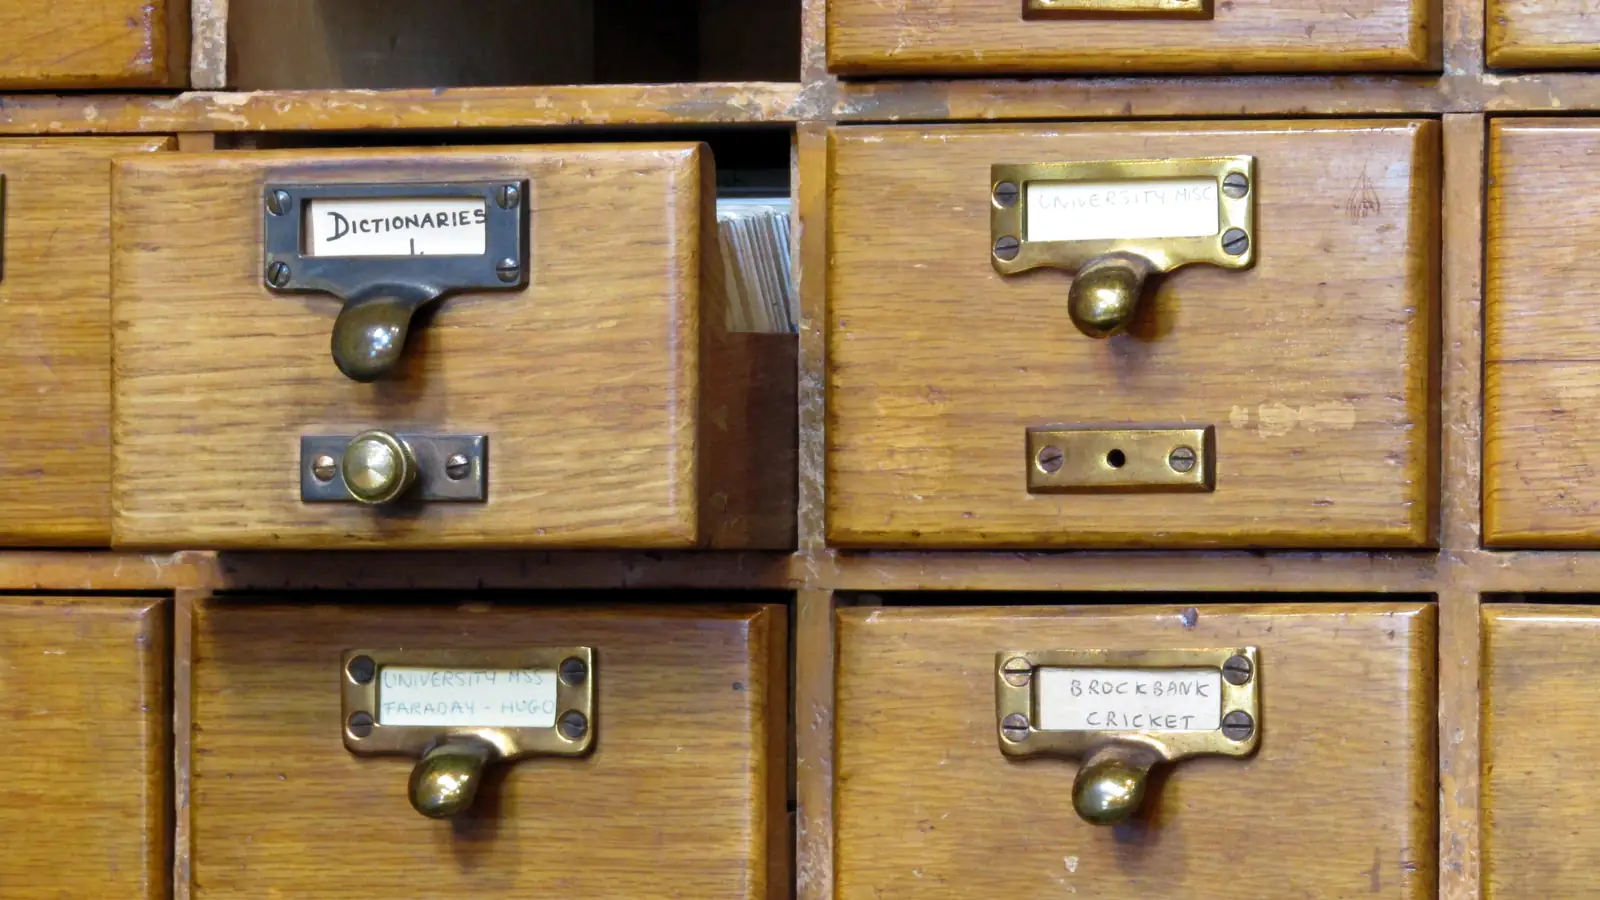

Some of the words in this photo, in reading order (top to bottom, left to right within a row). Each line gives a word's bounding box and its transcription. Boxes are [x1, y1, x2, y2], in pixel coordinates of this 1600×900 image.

[1038, 189, 1166, 210] UNIVERSITY
[326, 209, 486, 242] DICTIONARIES
[384, 670, 496, 689] UNIVERSITY
[508, 669, 544, 685] MSS
[1070, 679, 1209, 697] BROCKBANK
[384, 701, 475, 716] FARADAY
[501, 699, 555, 715] HUGO
[1086, 711, 1195, 730] CRICKET
